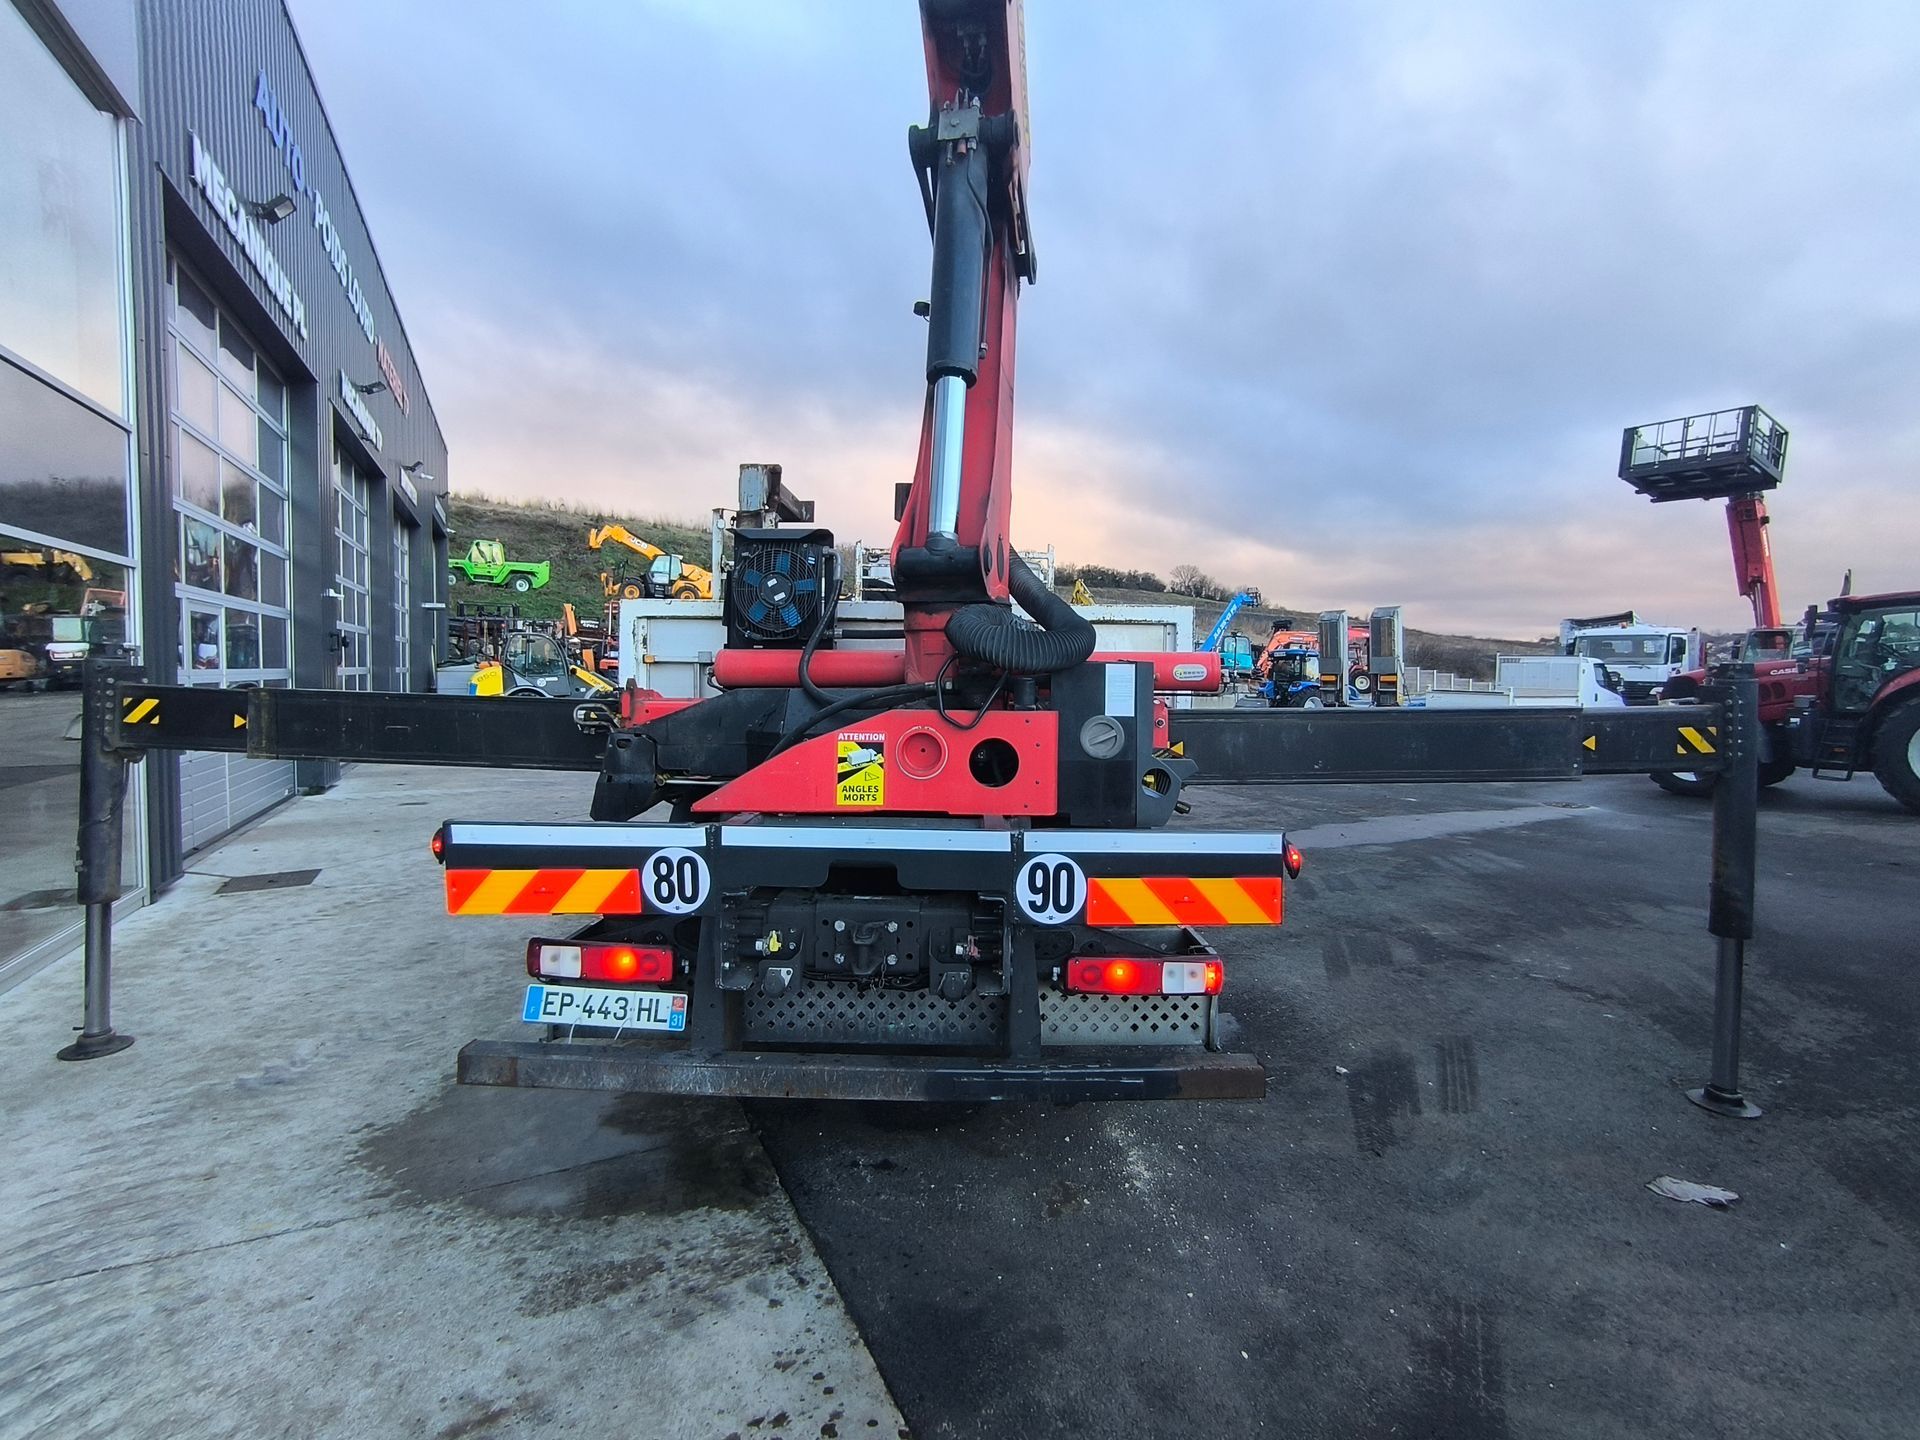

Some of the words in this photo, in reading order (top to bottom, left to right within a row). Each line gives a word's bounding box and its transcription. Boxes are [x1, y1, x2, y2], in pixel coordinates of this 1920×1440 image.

[255, 69, 305, 193] AUTO
[314, 189, 348, 288] POIDS
[348, 264, 375, 345] LOURD
[190, 129, 293, 320] MECANIQUE
[292, 288, 308, 341] PL
[838, 732, 885, 741] ATTENTION
[842, 785, 879, 793] ANGLES
[843, 793, 877, 802] MORTS
[653, 855, 700, 905] 80
[1028, 861, 1076, 914] 90
[671, 1013, 683, 1027] 31
